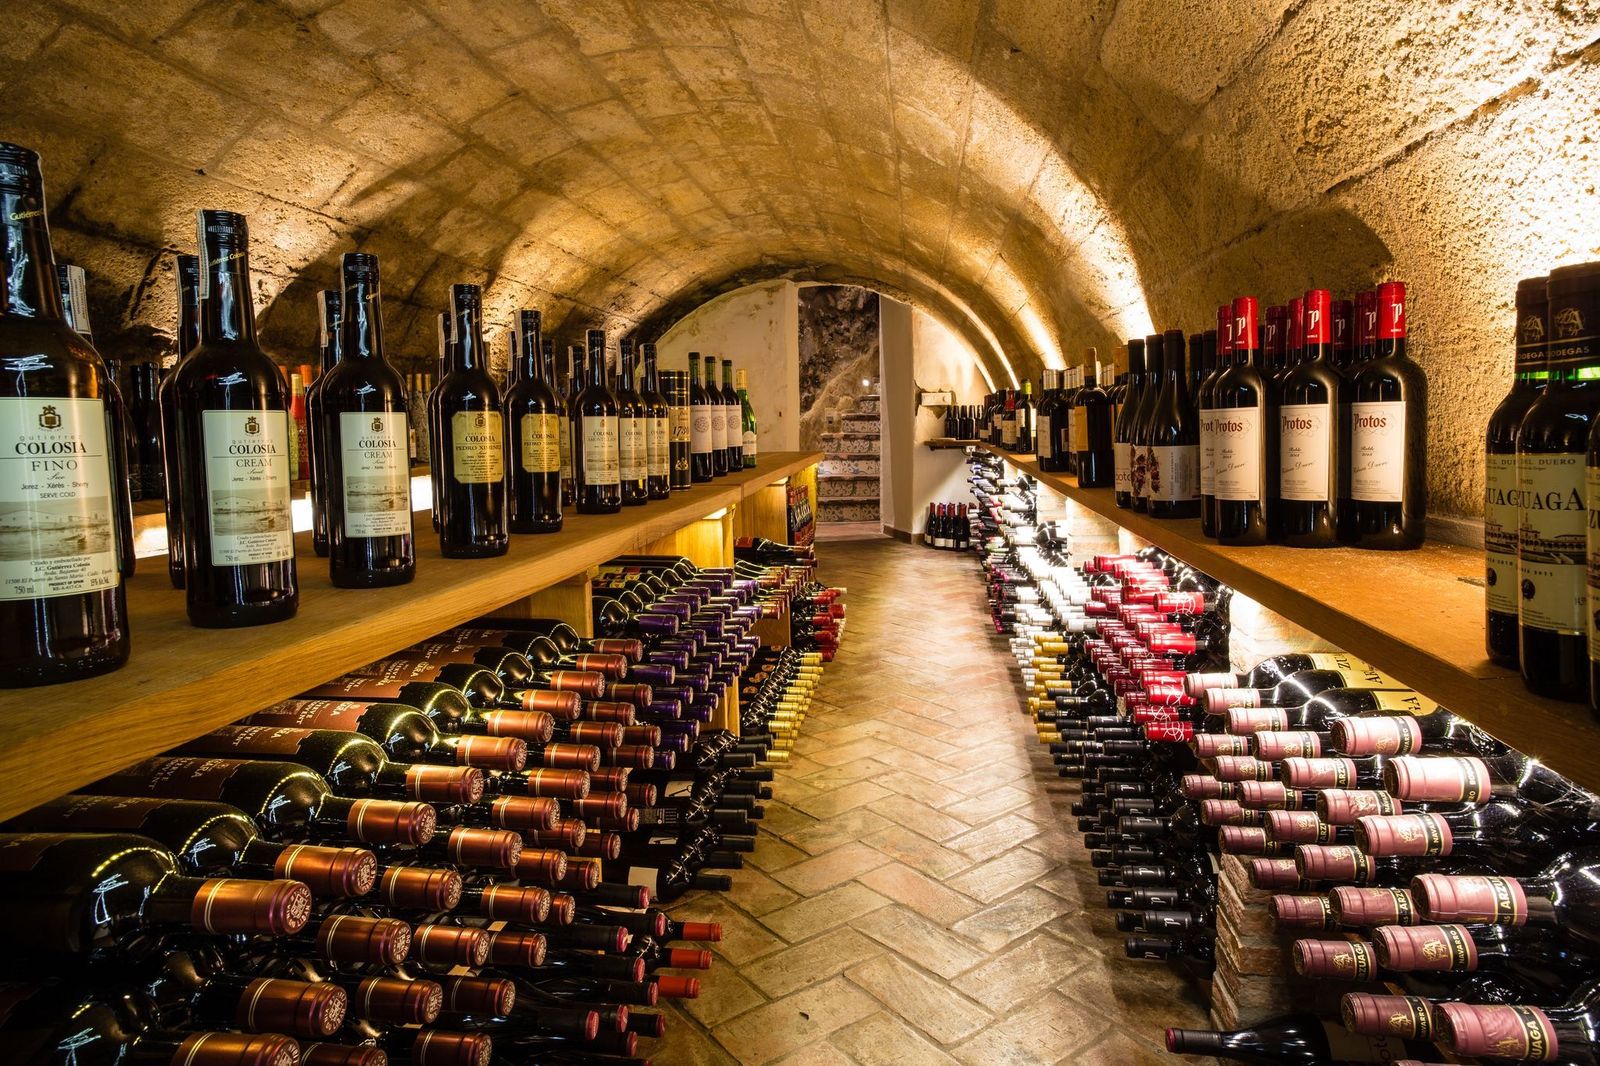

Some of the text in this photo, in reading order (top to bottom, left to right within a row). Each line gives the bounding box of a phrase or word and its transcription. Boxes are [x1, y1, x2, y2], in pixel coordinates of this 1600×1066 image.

[1215, 418, 1243, 435] Protos
[1281, 415, 1312, 433] Protos
[1353, 413, 1386, 431] Protos
[15, 441, 87, 455] COLOSIA
[229, 444, 276, 454] COLOSIA
[359, 440, 397, 448] COLOSIA
[364, 451, 392, 459] CREAM
[31, 460, 78, 472] FINO
[236, 458, 272, 467] CREAM
[1518, 487, 1587, 511] UAGA
[1450, 930, 1465, 964] NAVARRO
